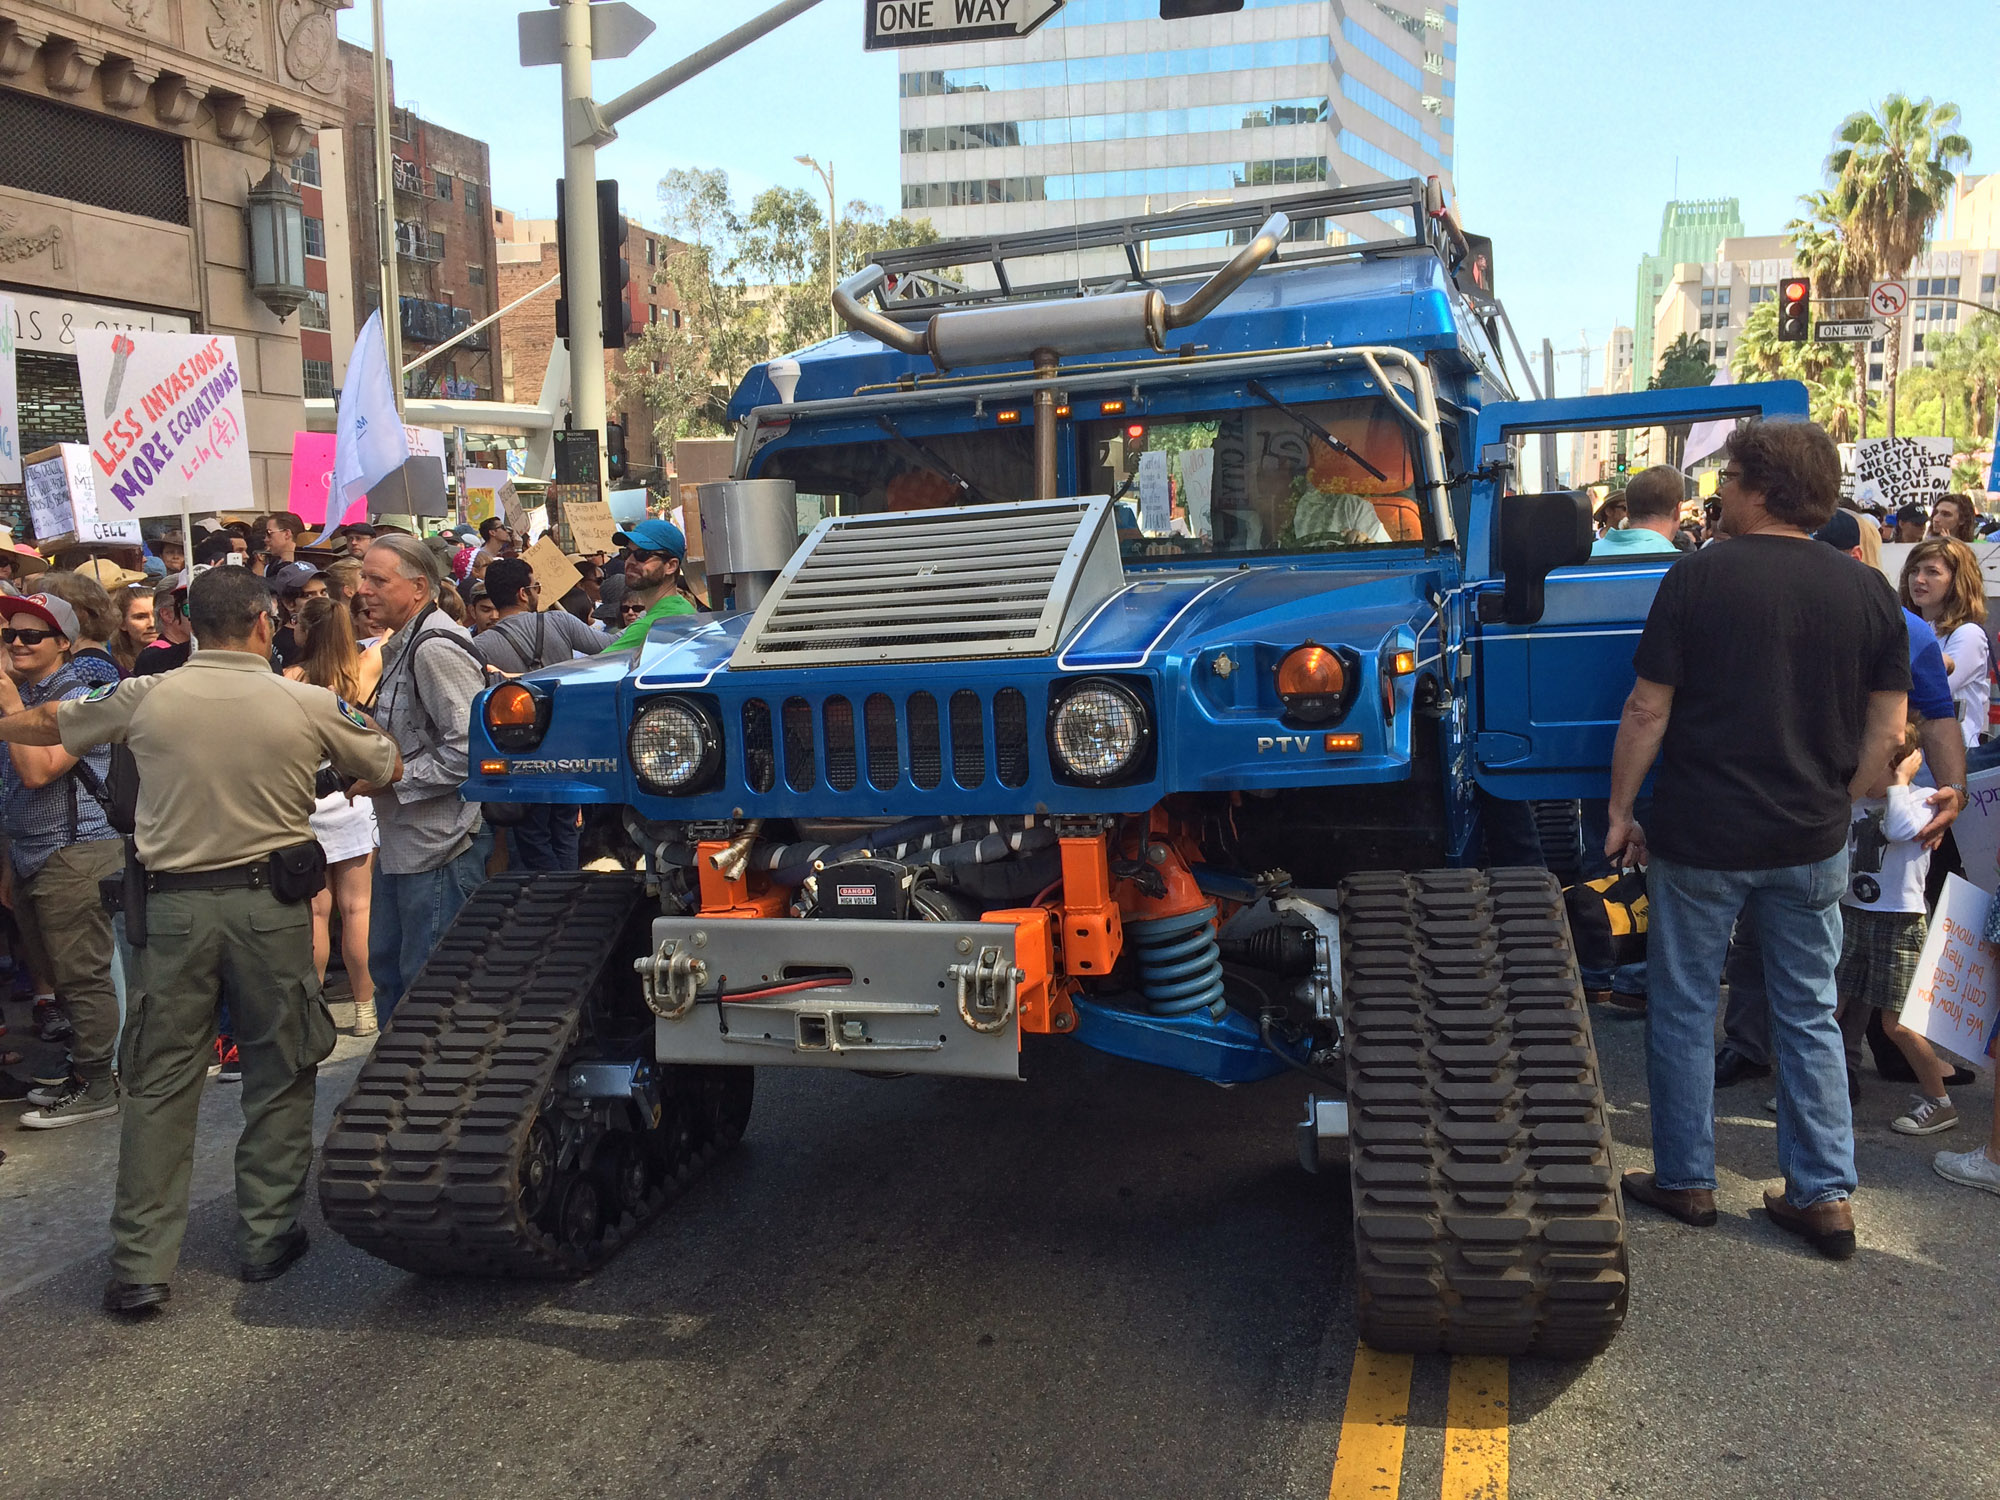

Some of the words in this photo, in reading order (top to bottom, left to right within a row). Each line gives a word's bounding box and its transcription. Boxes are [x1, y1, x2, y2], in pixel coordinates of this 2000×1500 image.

[880, 2, 933, 31] ONE
[955, 0, 1008, 24] WAY
[59, 312, 75, 345] &
[1823, 325, 1847, 337] ONE
[1853, 324, 1876, 336] WAY
[92, 407, 144, 477] LESS
[140, 337, 224, 424] INVASIONS
[110, 431, 174, 512] MORE
[167, 361, 238, 446] EQUATIONS
[1860, 437, 1918, 460] BREAK
[1857, 458, 1883, 473] THE
[1919, 454, 1952, 468] RISE
[1881, 478, 1930, 498] FOCUS
[1932, 477, 1950, 491] ON
[94, 523, 126, 539] CELL
[1257, 736, 1310, 753] PTV
[511, 758, 617, 775] ZEROSOUTH
[1942, 918, 1976, 945] movie
[1942, 940, 1963, 973] they
[1978, 941, 1985, 952] a
[1967, 963, 1985, 979] but
[1917, 985, 1941, 1008] you
[1936, 998, 1963, 1030] know
[1966, 1013, 1984, 1041] We
